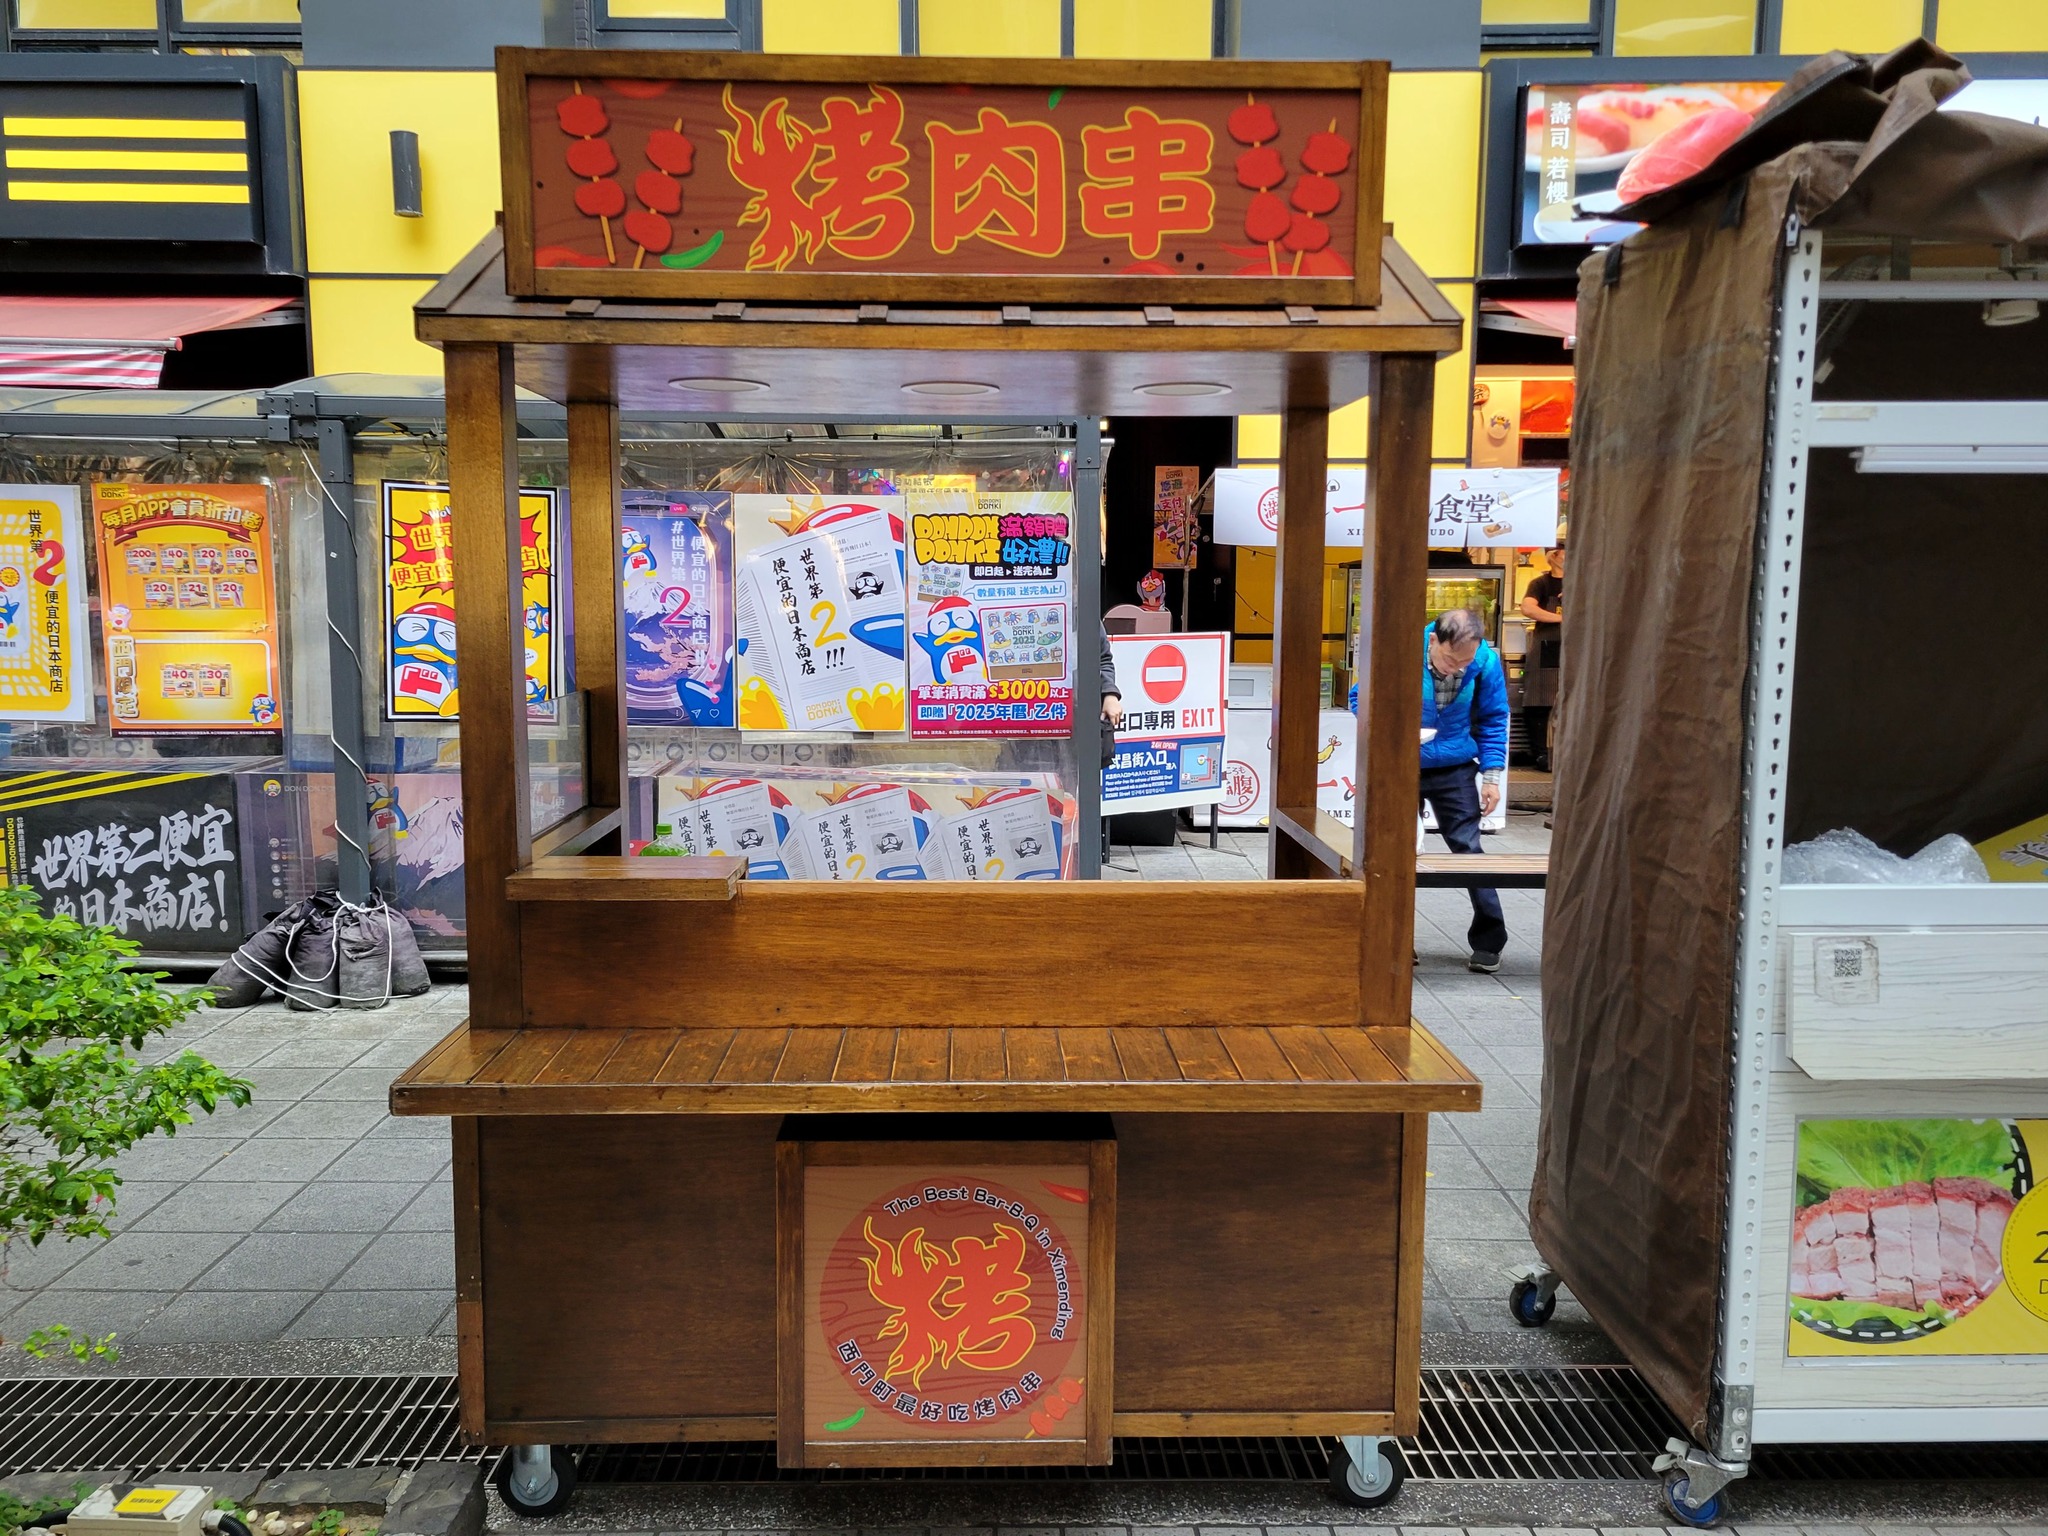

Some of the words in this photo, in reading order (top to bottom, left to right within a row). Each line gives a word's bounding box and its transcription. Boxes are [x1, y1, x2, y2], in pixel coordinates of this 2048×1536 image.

[1549, 101, 1572, 149] 壽司
[716, 81, 1214, 273] 烤肉串
[1546, 156, 1569, 204] 若櫻
[1346, 528, 1364, 536] XI
[1429, 528, 1455, 536] UDO
[800, 548, 824, 601] 世界第
[773, 558, 816, 676] 便宜的日本商店
[810, 600, 847, 648] 2
[1012, 636, 1035, 645] 2025
[45, 590, 63, 693] 便宜的日本商店
[989, 680, 1050, 700] $3000
[1050, 689, 1068, 698] 以上
[1182, 708, 1215, 729] EXIT
[31, 803, 235, 891] 世界第二便宜
[678, 817, 697, 855] 便宜的
[699, 810, 718, 850] 世界第
[839, 814, 857, 853] 世界第
[957, 825, 977, 880] 便宜的日
[978, 818, 996, 858] 世界第
[884, 1194, 920, 1217] The
[924, 1186, 969, 1203] Best
[974, 1188, 1041, 1232] Bar-B-Q
[1036, 1228, 1053, 1248] in
[1047, 1247, 1074, 1340] Ximending
[837, 1339, 1043, 1422] 西門町最好吃烤肉串
